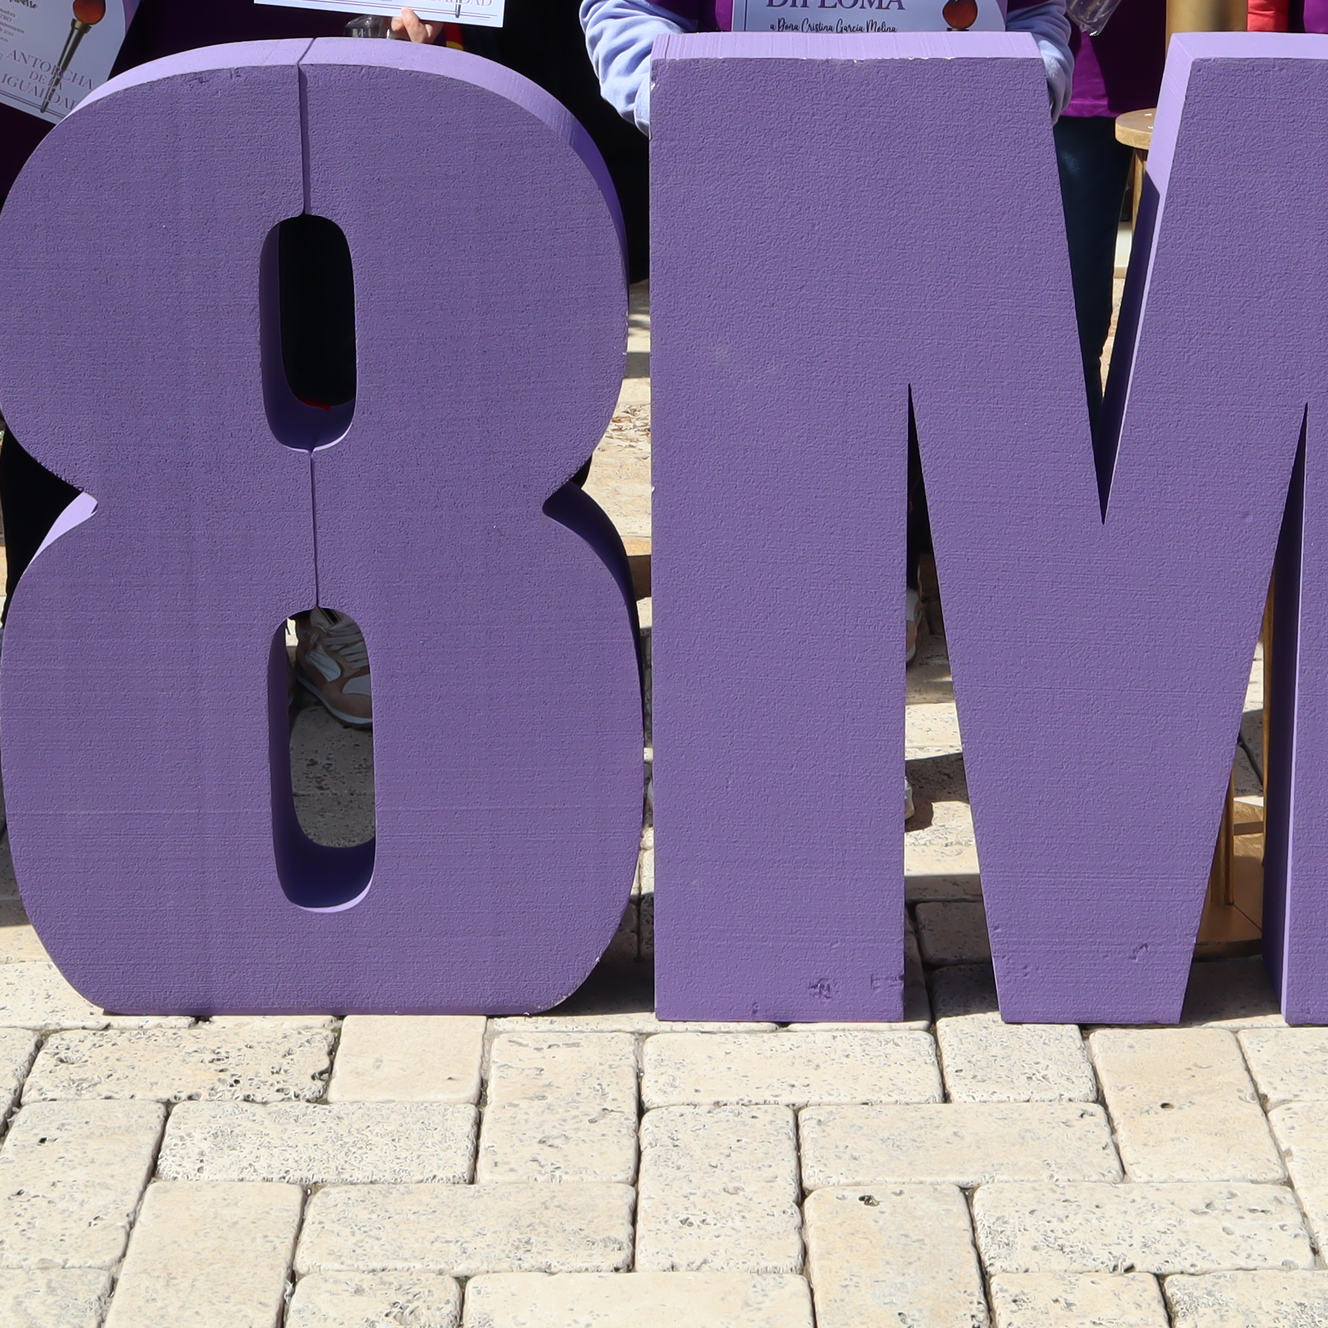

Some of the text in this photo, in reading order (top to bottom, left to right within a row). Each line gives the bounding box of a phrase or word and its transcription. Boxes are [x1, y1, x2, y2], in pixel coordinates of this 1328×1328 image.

[801, 17, 834, 32] Cristina
[835, 18, 864, 33] García
[865, 18, 898, 32] Molina
[6, 48, 94, 90] ANTORCHA
[29, 70, 48, 85] DE
